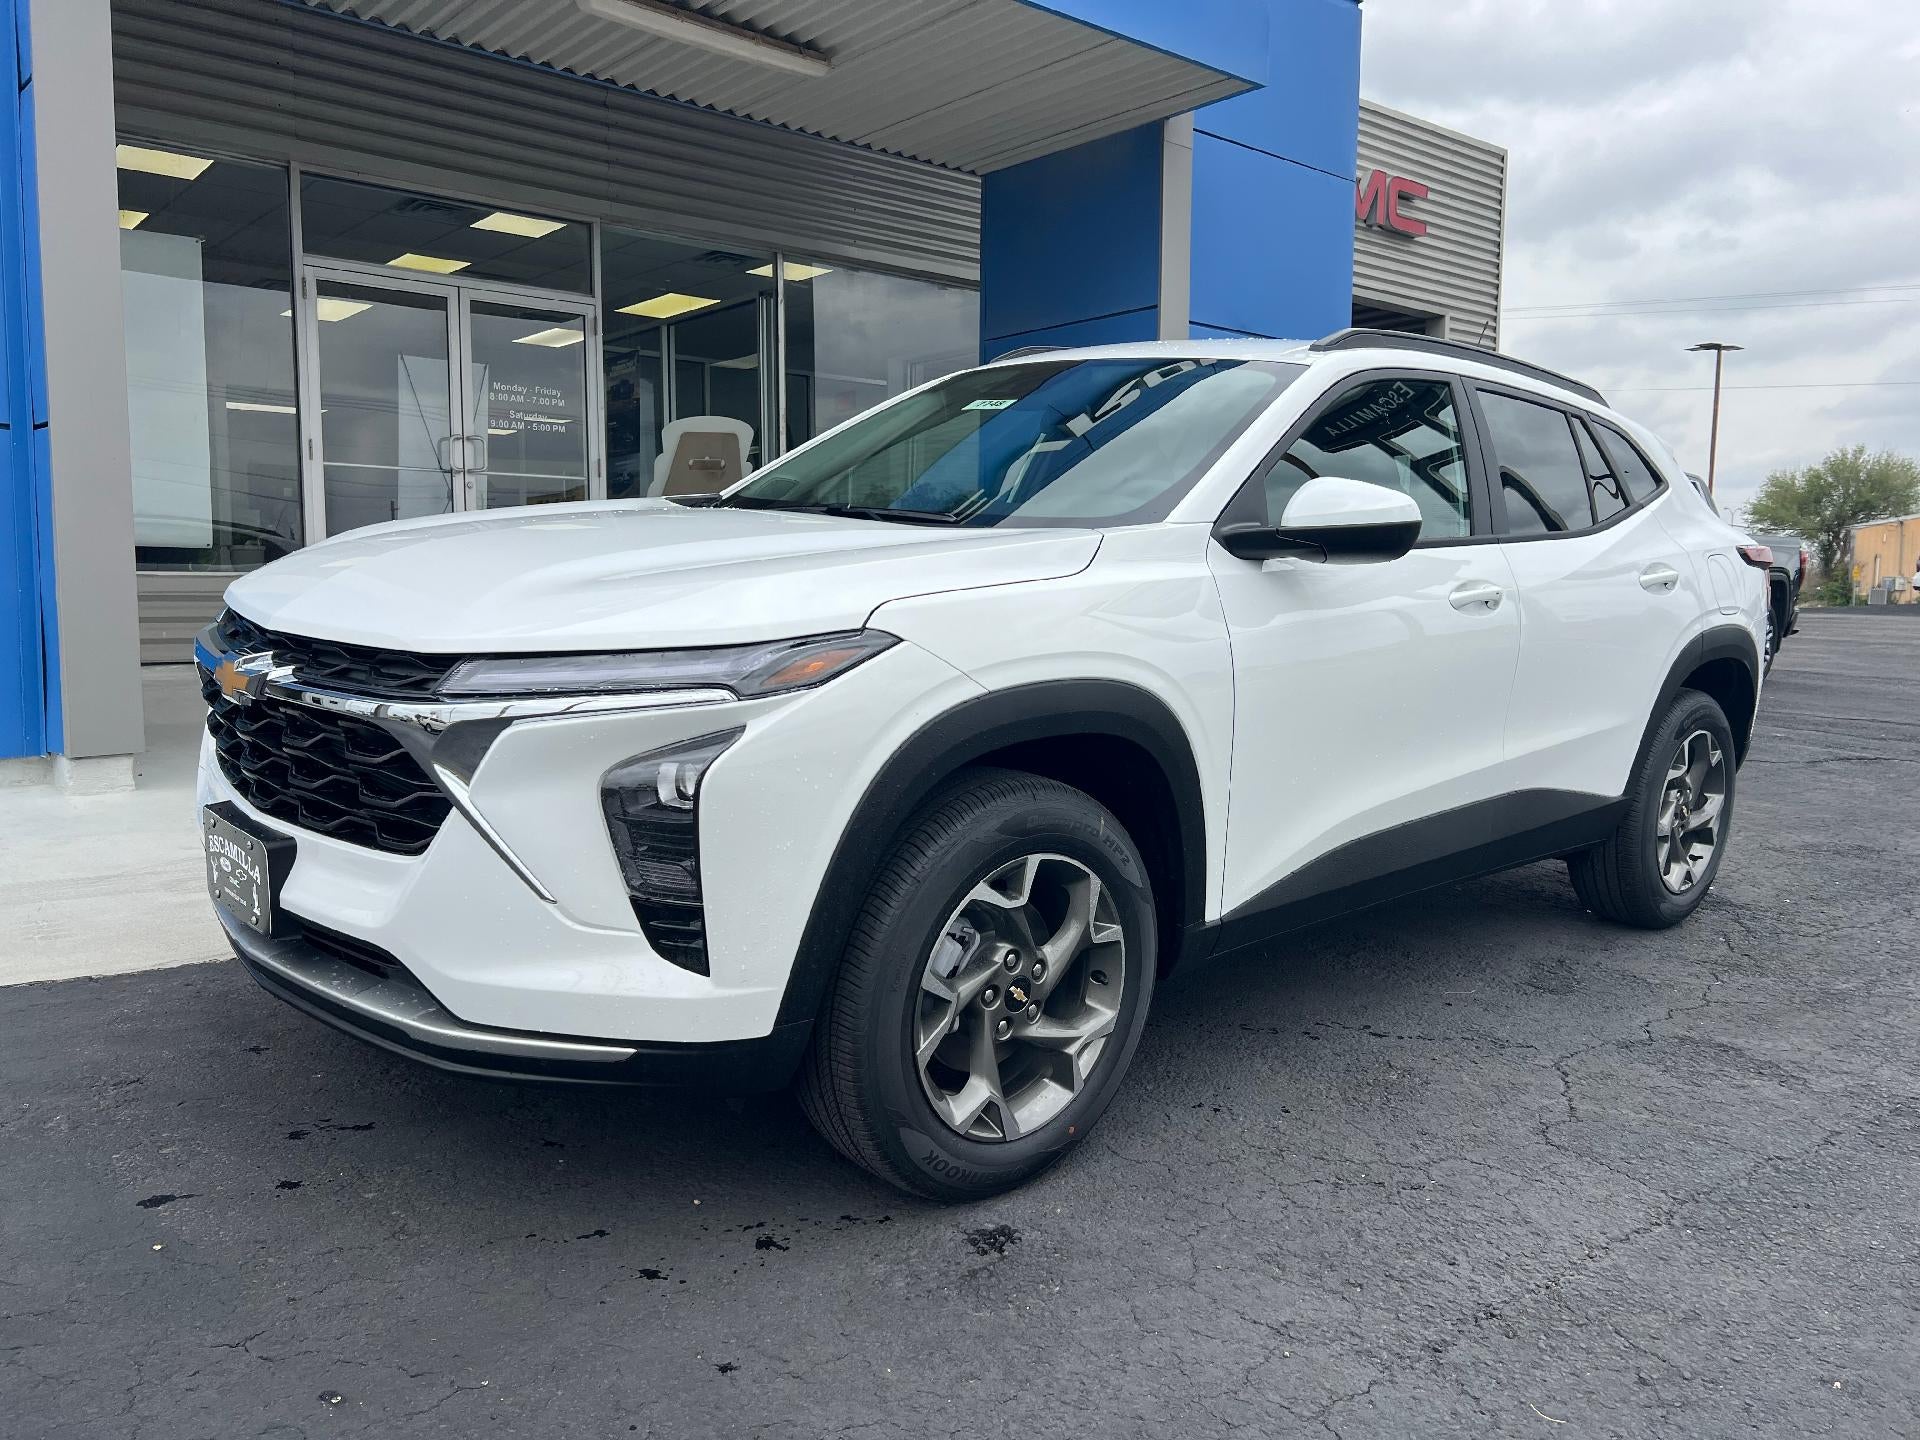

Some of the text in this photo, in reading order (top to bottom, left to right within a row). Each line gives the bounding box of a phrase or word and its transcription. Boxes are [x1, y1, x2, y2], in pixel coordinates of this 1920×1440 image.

[493, 382, 527, 394] Monday
[535, 386, 562, 398] Friday
[489, 392, 508, 401] 8:00
[510, 394, 524, 403] AM
[552, 398, 565, 407] PM
[509, 409, 548, 421] Saturday
[511, 421, 525, 430] AM
[532, 423, 551, 432] 5:00
[552, 424, 566, 433] PM
[208, 834, 261, 886] ESCAMILLA
